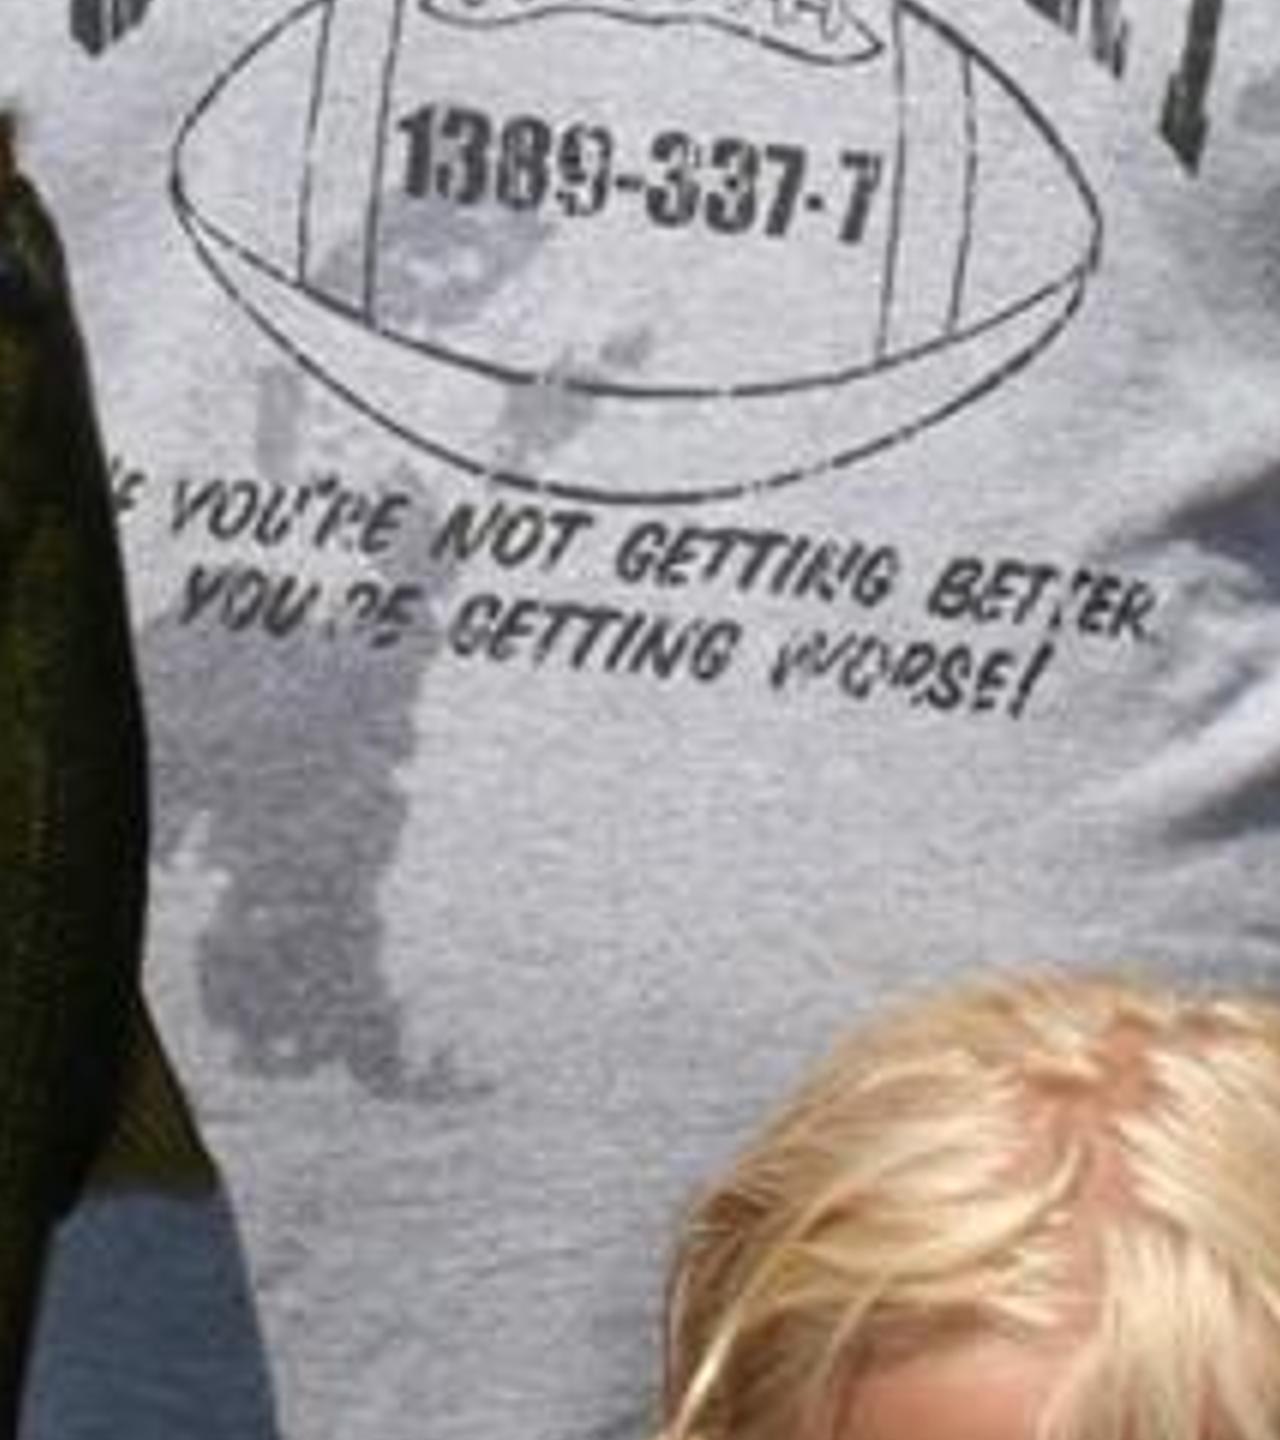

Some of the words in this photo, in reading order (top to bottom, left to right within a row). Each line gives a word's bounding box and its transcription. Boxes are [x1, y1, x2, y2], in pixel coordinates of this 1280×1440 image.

[430, 502, 594, 567] NOT
[616, 522, 901, 608] GETTING
[182, 564, 424, 650] YOURE
[448, 593, 740, 682] GETTING
